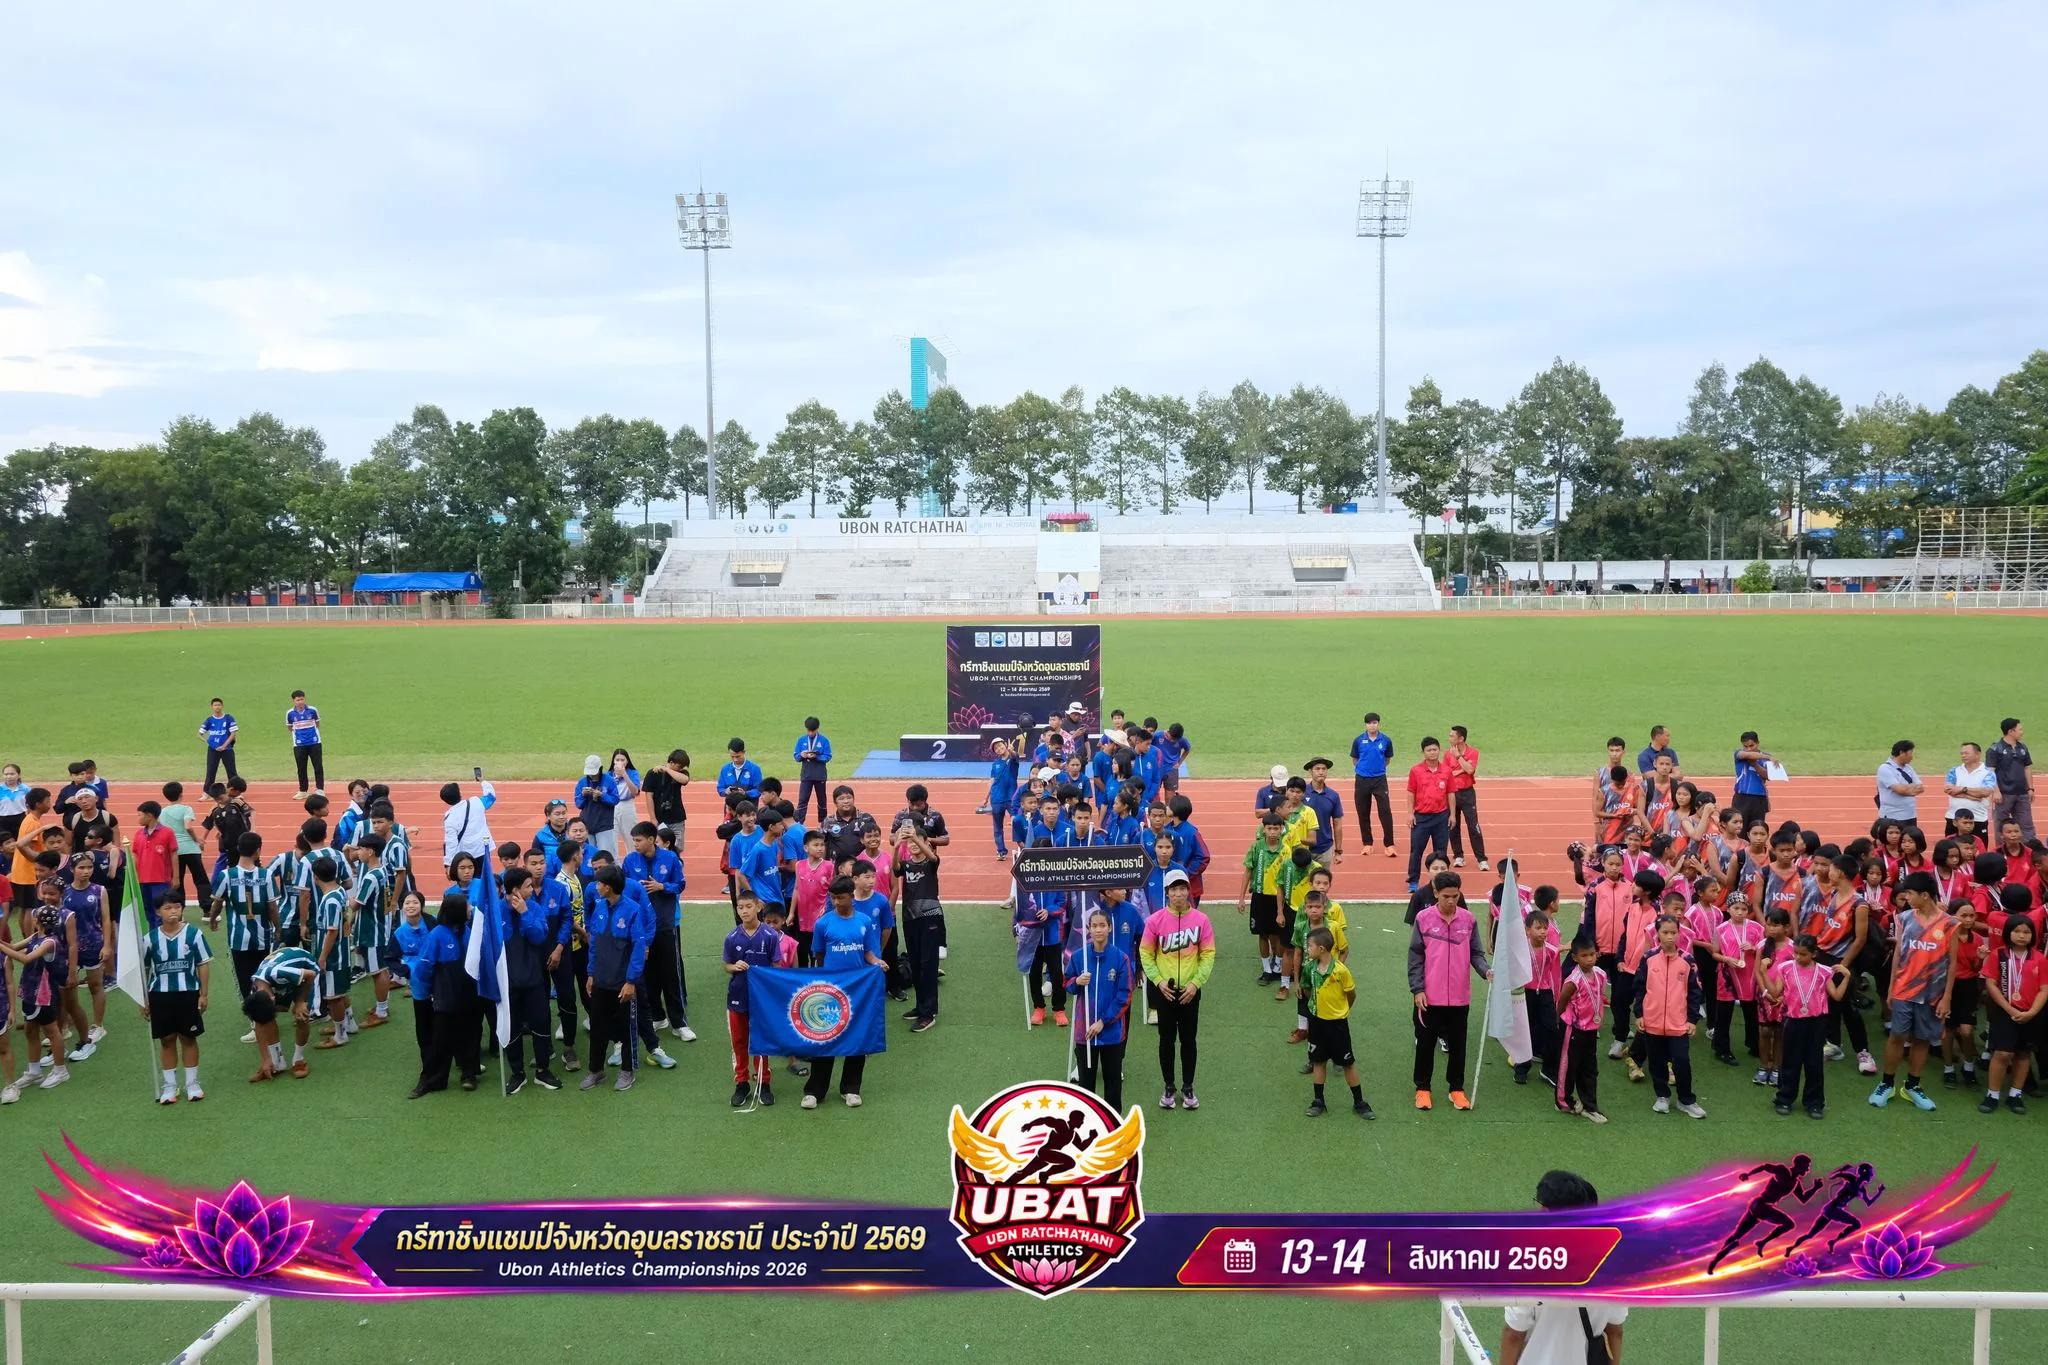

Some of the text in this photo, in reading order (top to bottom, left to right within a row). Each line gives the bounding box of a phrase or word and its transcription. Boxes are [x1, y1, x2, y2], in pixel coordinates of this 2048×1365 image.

[839, 521, 879, 534] UBON
[884, 520, 967, 534] RATCHATHA
[930, 740, 947, 760] 2
[1015, 733, 1027, 758] 1
[1652, 801, 1669, 811] KNP
[1047, 874, 1085, 882] ATHLETICS
[1087, 872, 1141, 880] CHAMPIONSHIPS
[1159, 926, 1201, 954] UBN
[1909, 939, 1938, 951] KNP
